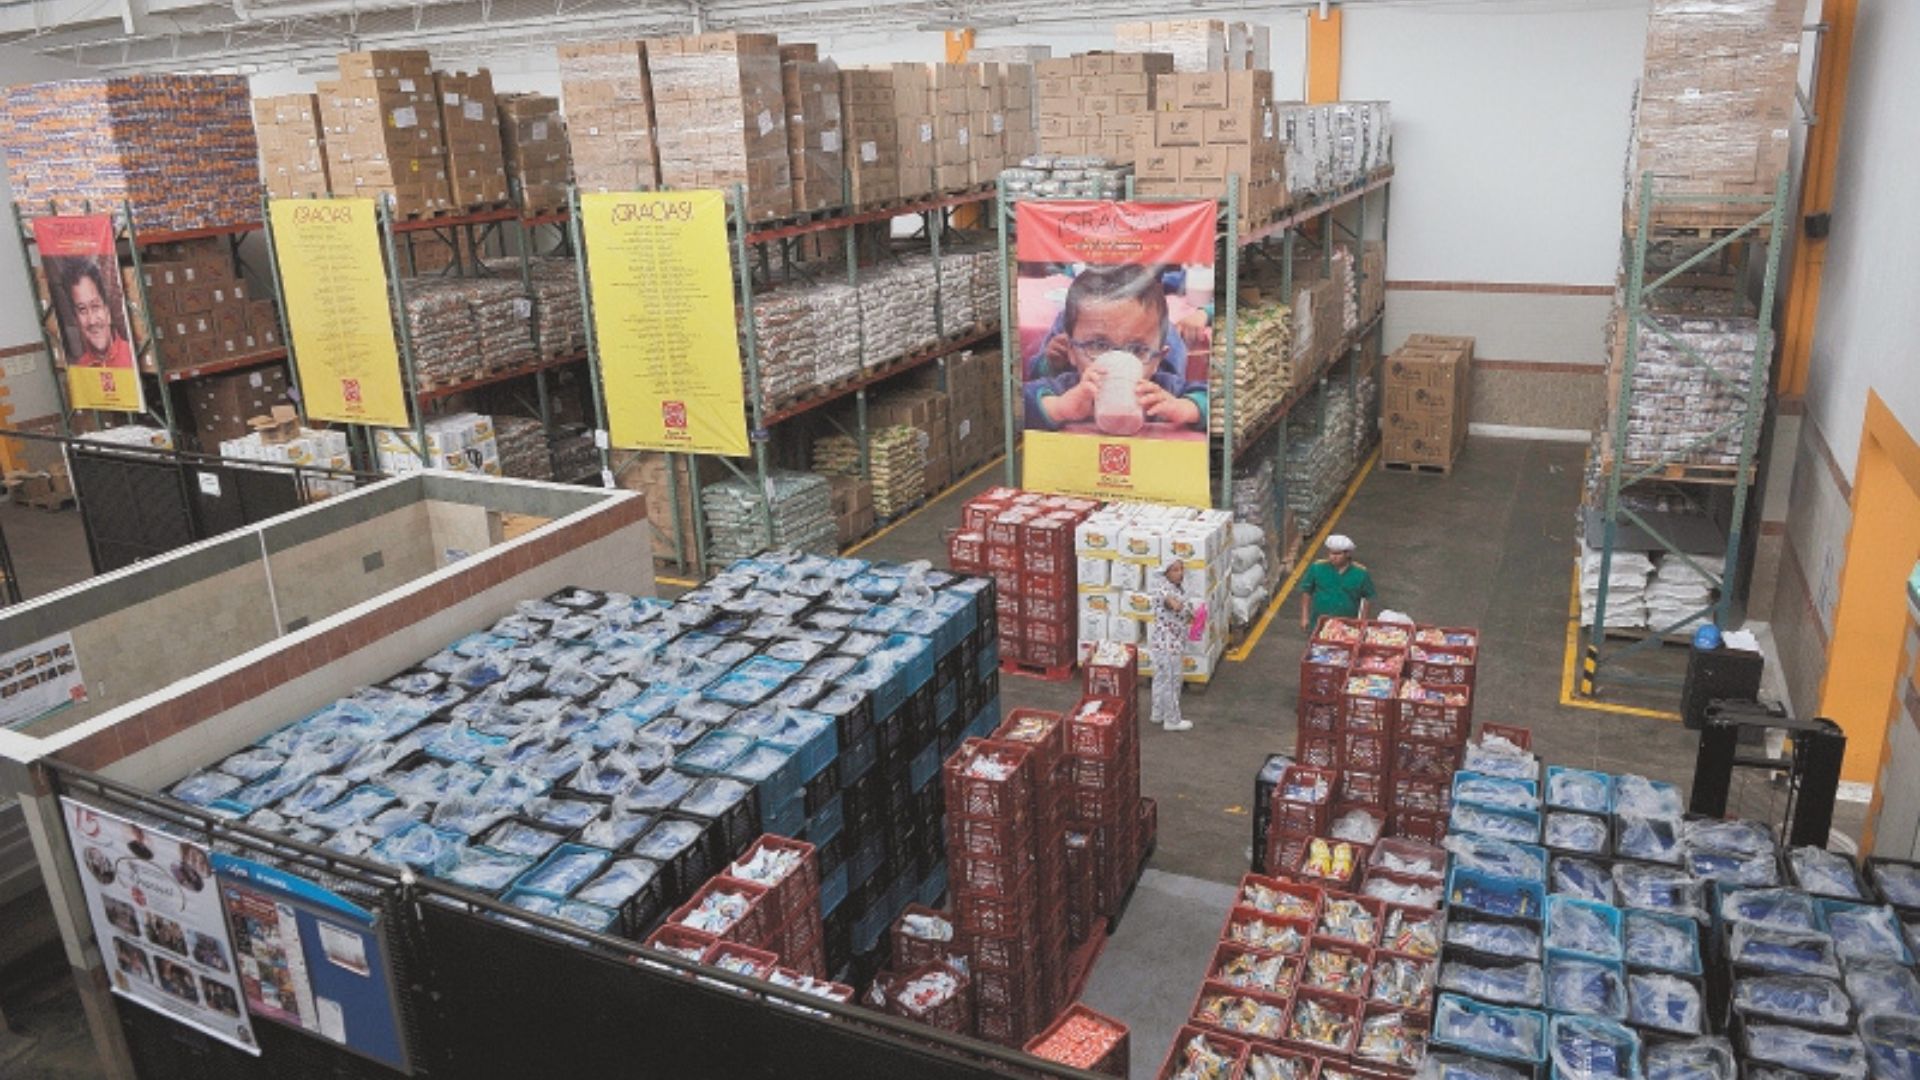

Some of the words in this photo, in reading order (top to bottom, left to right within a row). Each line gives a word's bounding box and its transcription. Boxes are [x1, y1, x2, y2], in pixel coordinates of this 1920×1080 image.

[611, 201, 695, 226] ¡GRACIAS!
[1057, 211, 1170, 238] ¡GRACIAS!
[74, 806, 100, 837] 15
